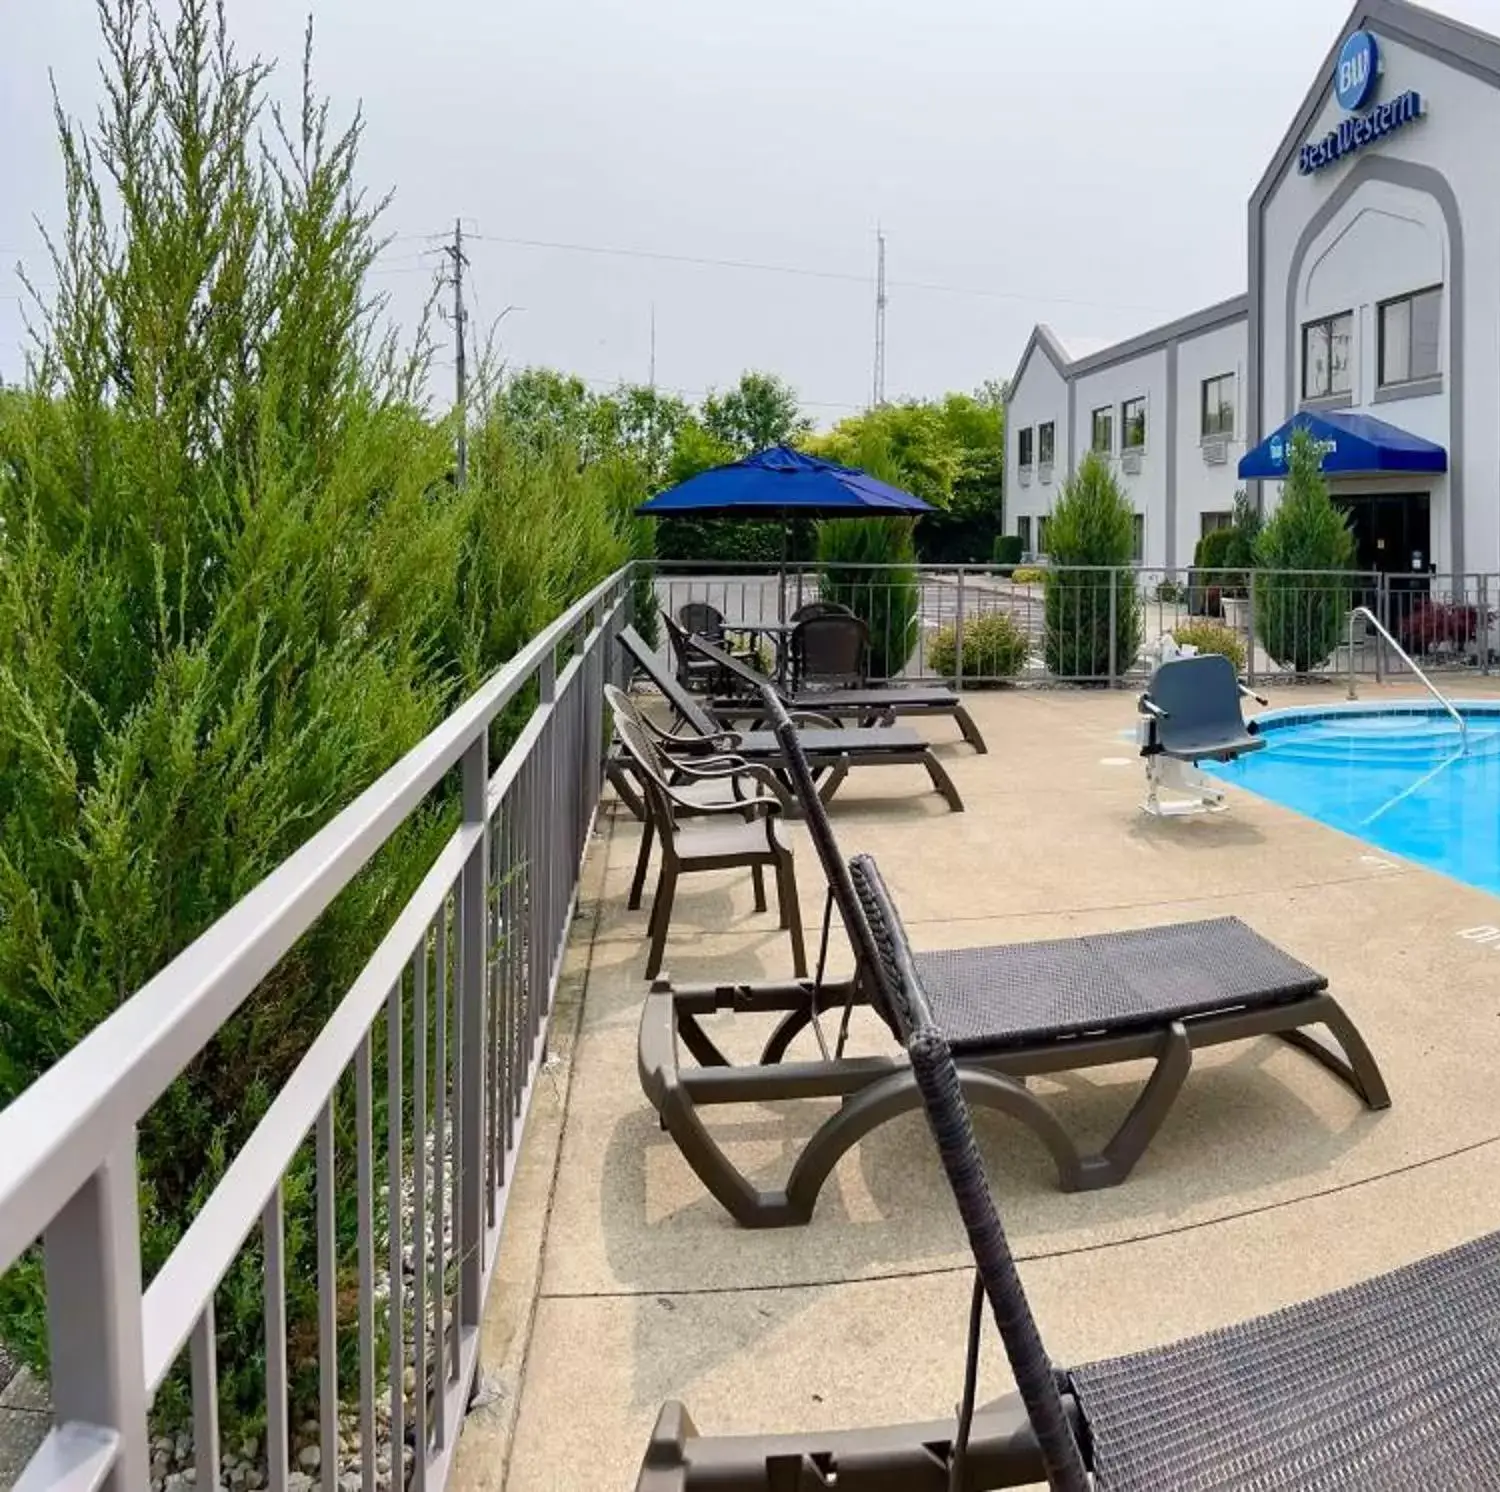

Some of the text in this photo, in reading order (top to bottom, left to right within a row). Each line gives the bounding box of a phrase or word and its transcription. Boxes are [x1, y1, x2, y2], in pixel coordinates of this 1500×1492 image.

[1339, 48, 1371, 94] BW
[1299, 89, 1419, 174] Best Western
